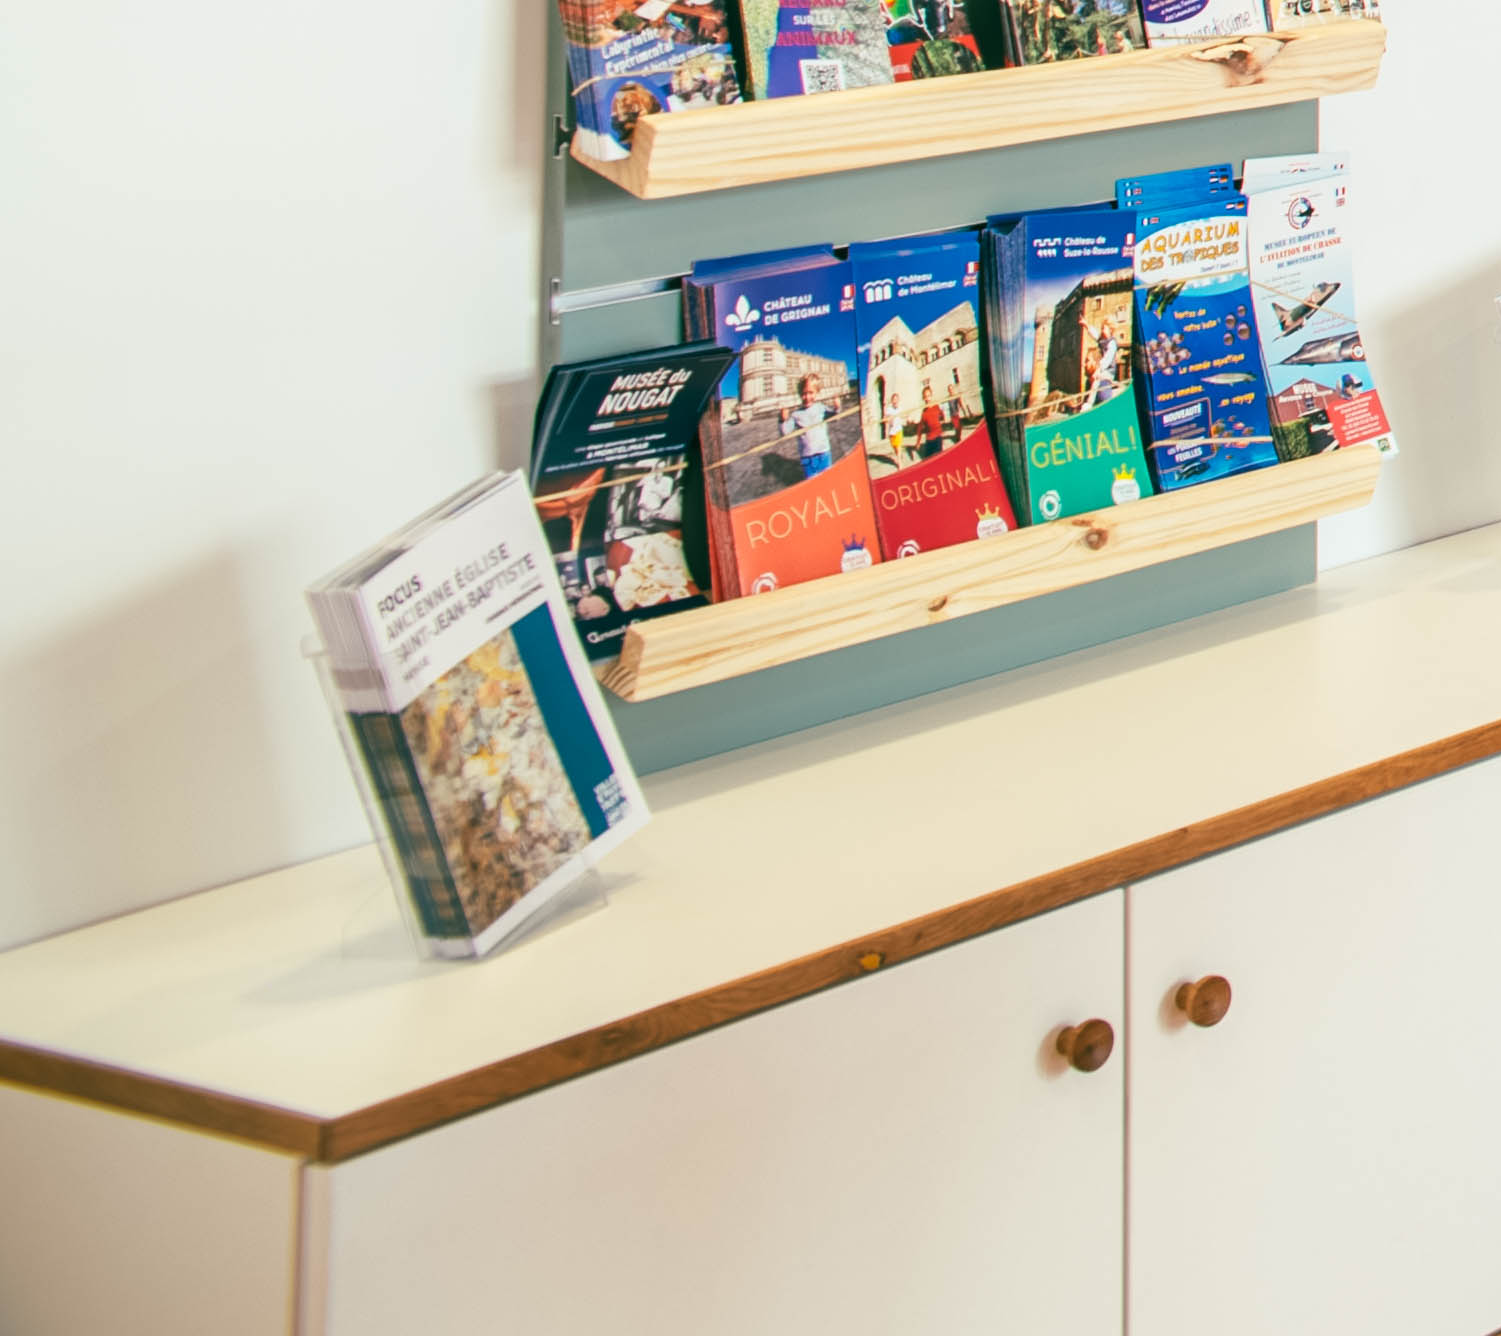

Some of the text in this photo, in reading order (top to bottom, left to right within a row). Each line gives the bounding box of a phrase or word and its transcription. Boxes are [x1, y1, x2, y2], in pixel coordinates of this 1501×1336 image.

[793, 14, 817, 26] SUR
[602, 26, 659, 60] Labyrinthe
[776, 30, 857, 47] ANIMAUX
[1063, 235, 1095, 247] Château
[1141, 220, 1240, 256] AQUARIUM
[1140, 256, 1165, 273] DES
[896, 272, 933, 286] Château
[897, 279, 958, 298] de Montélimar
[763, 294, 813, 313] CHÂTEAU
[764, 304, 831, 326] DE GRIGNAN
[611, 366, 693, 392] MUSÉE du
[597, 384, 685, 417] NOUGAT
[1030, 434, 1138, 471] GÉNIAL!
[879, 459, 999, 513] ORIGINAL!
[377, 574, 422, 620] FOCUS
[385, 541, 511, 641] ANCIENNE ÉGLISE
